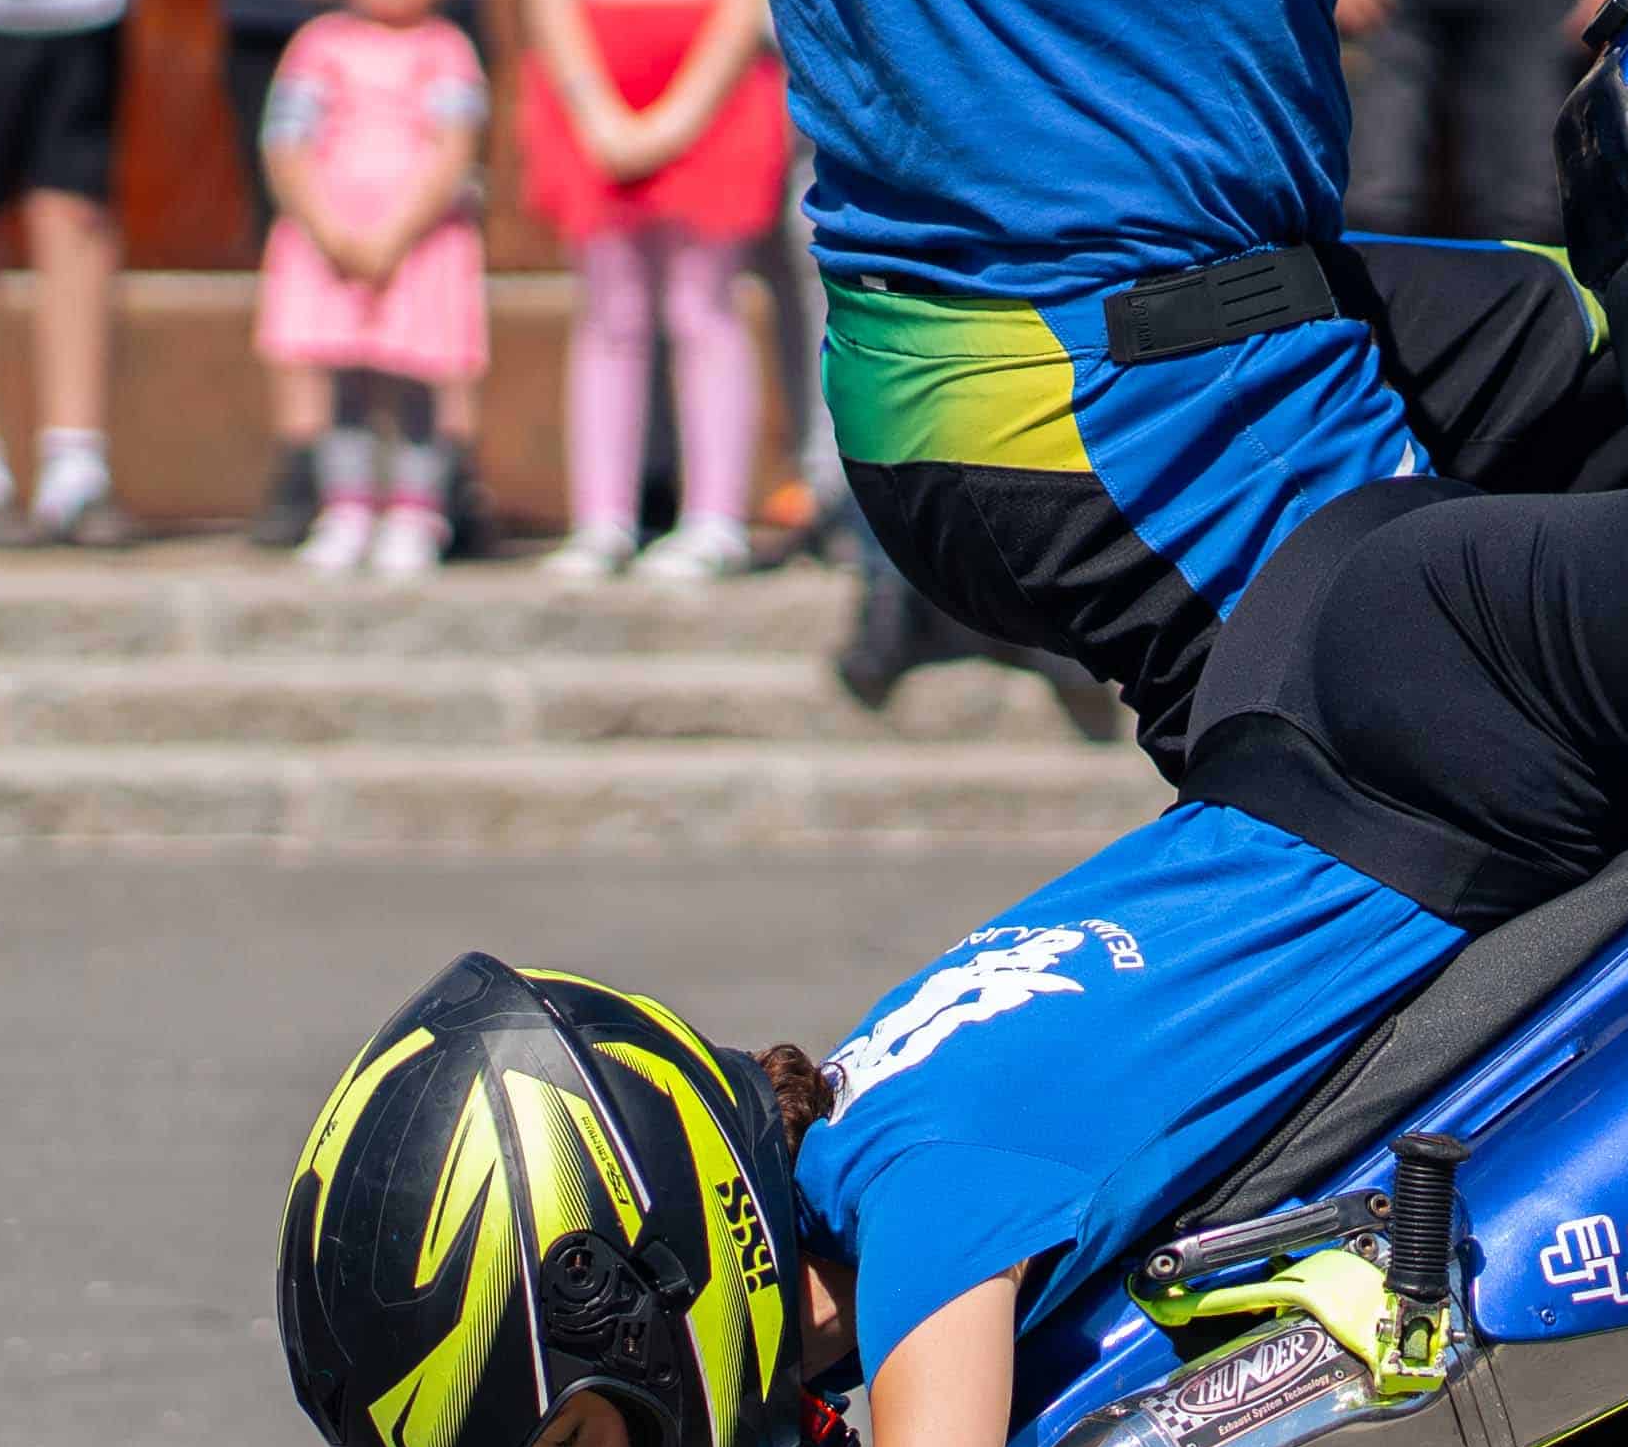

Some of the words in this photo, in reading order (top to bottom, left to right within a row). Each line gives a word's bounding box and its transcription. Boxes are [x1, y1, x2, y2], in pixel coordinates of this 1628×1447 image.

[1192, 1332, 1309, 1404] THUNDER
[1218, 1412, 1252, 1436] Exhaust
[1251, 1396, 1283, 1419] System
[1282, 1373, 1331, 1404] Technology
